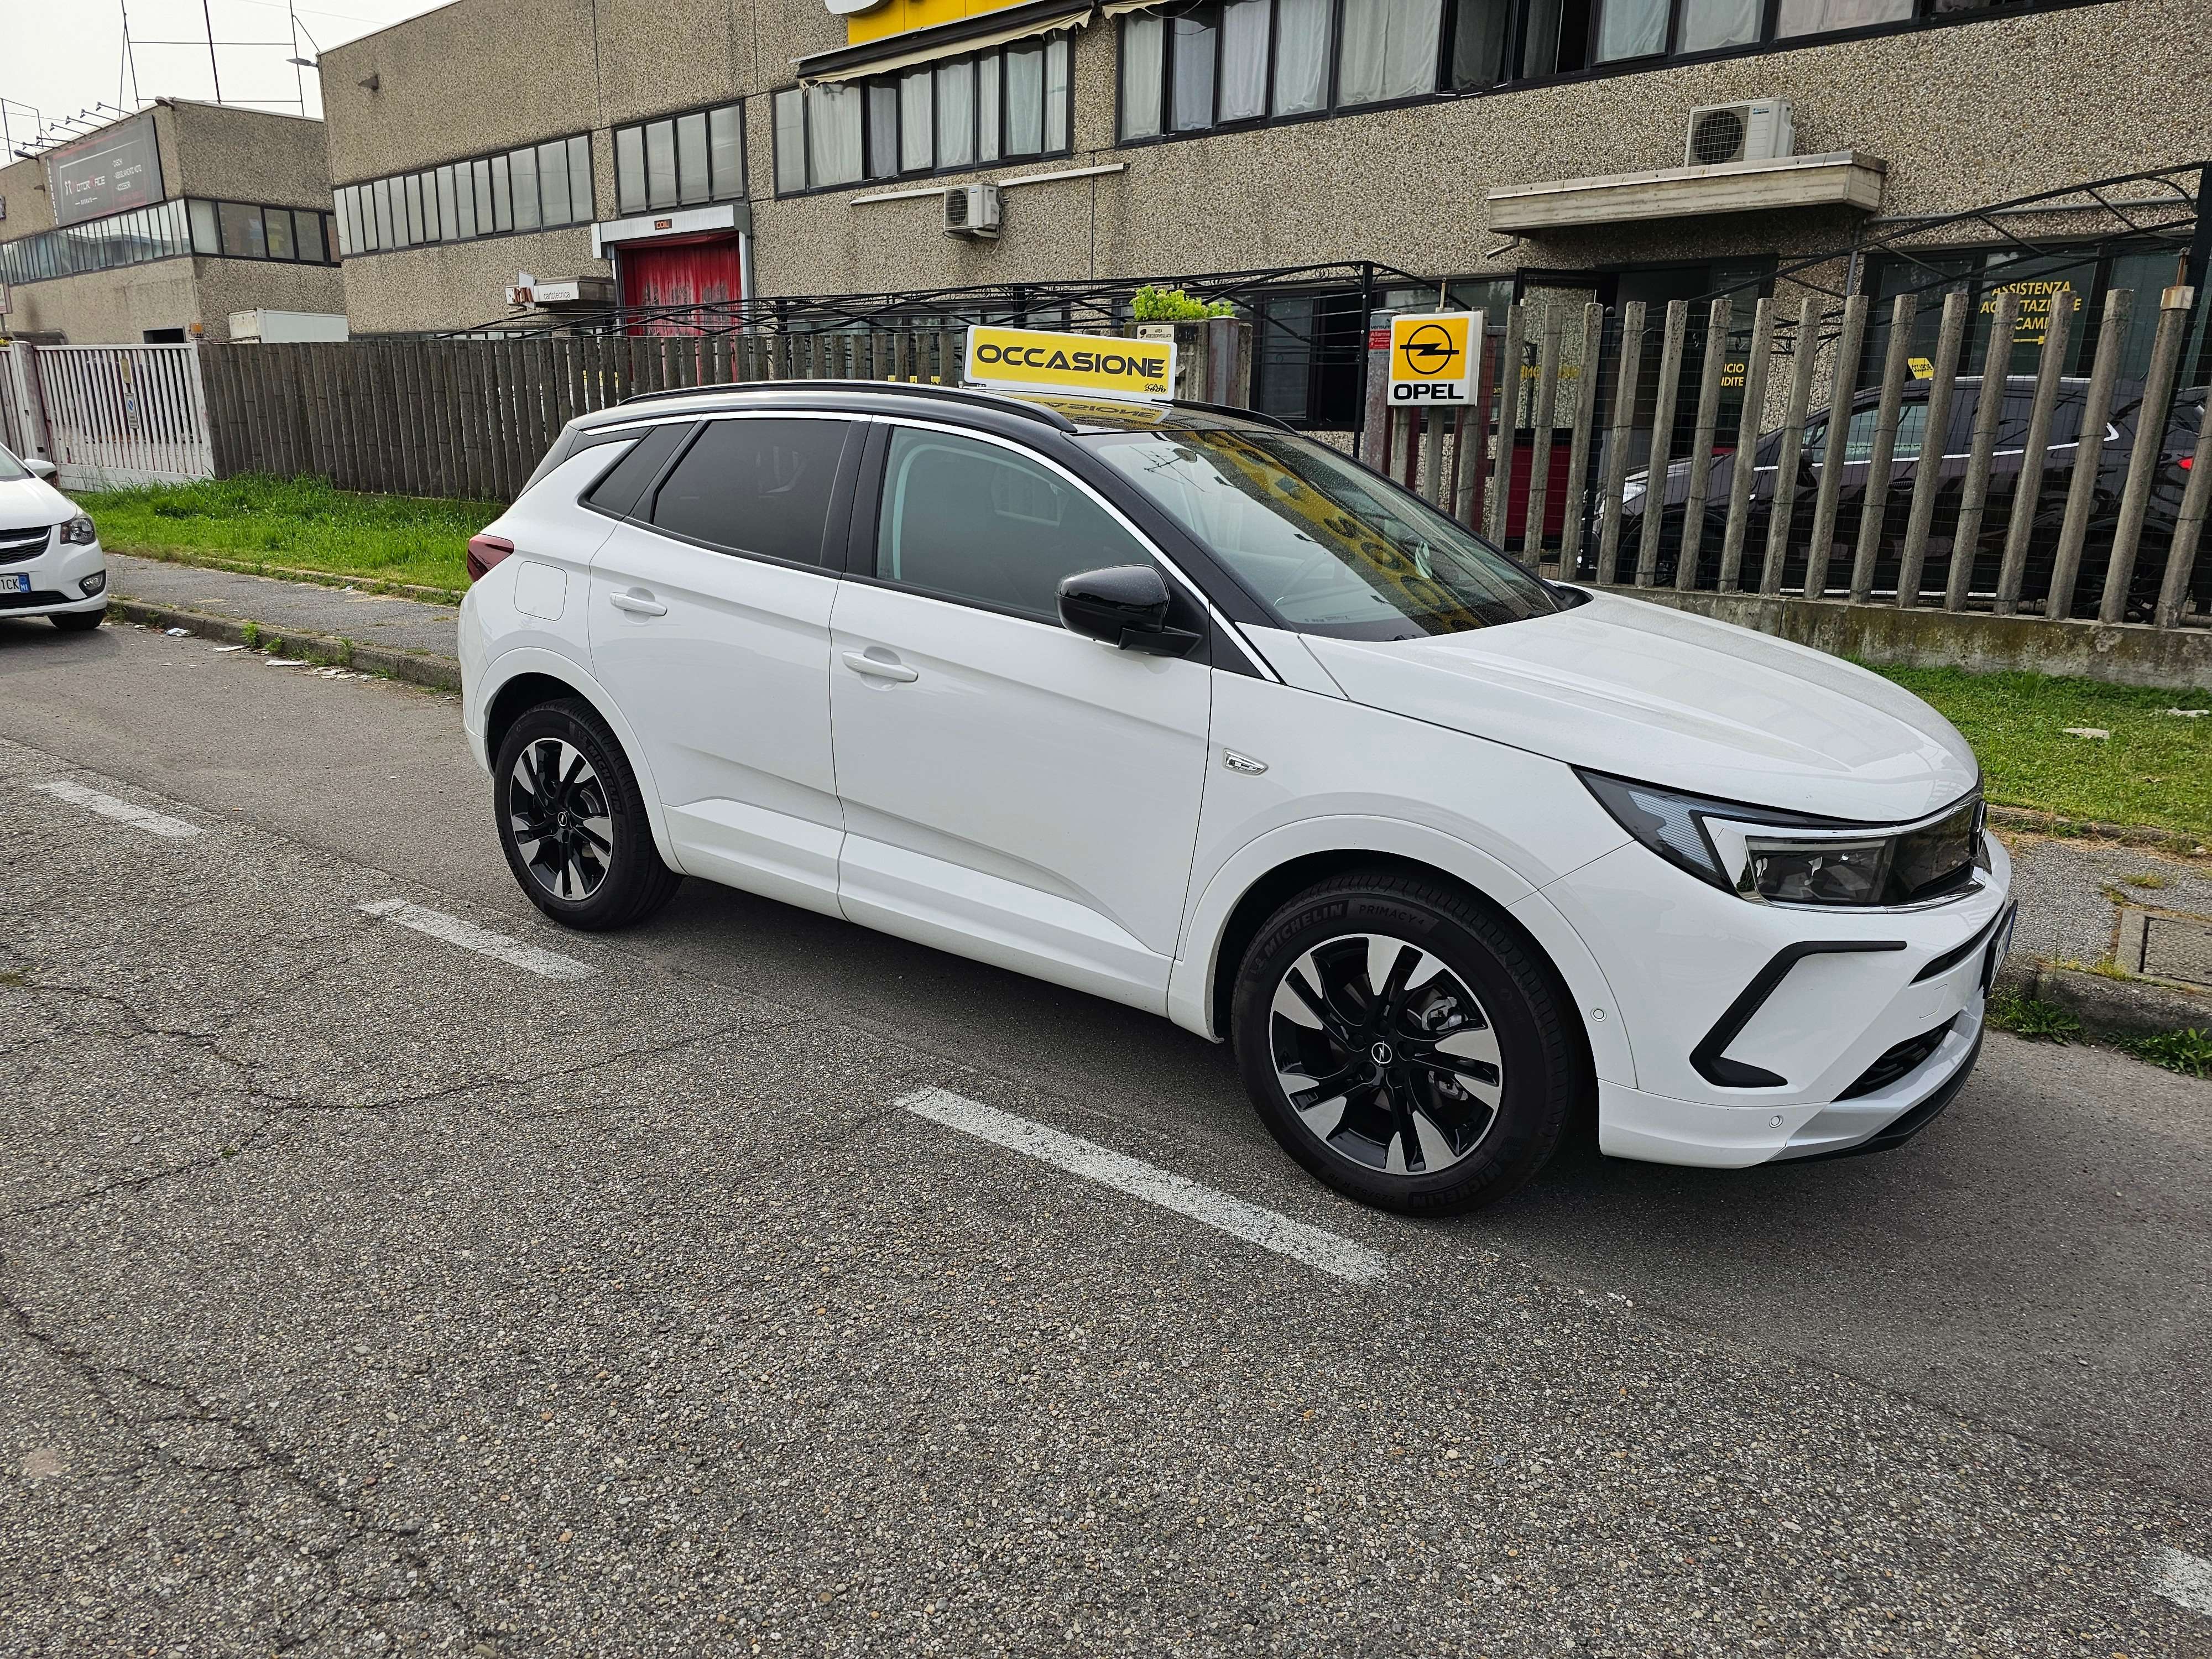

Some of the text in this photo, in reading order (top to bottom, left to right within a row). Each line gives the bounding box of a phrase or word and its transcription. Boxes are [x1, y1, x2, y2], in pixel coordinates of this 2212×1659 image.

[1979, 298, 2081, 314] ACTAZIE
[977, 344, 1165, 378] OCCASIONE
[1394, 383, 1464, 400] OPEL
[587, 744, 622, 812] MICHELIN
[1263, 903, 1344, 957] MICHELIN
[1359, 905, 1417, 924] PRIMACY
